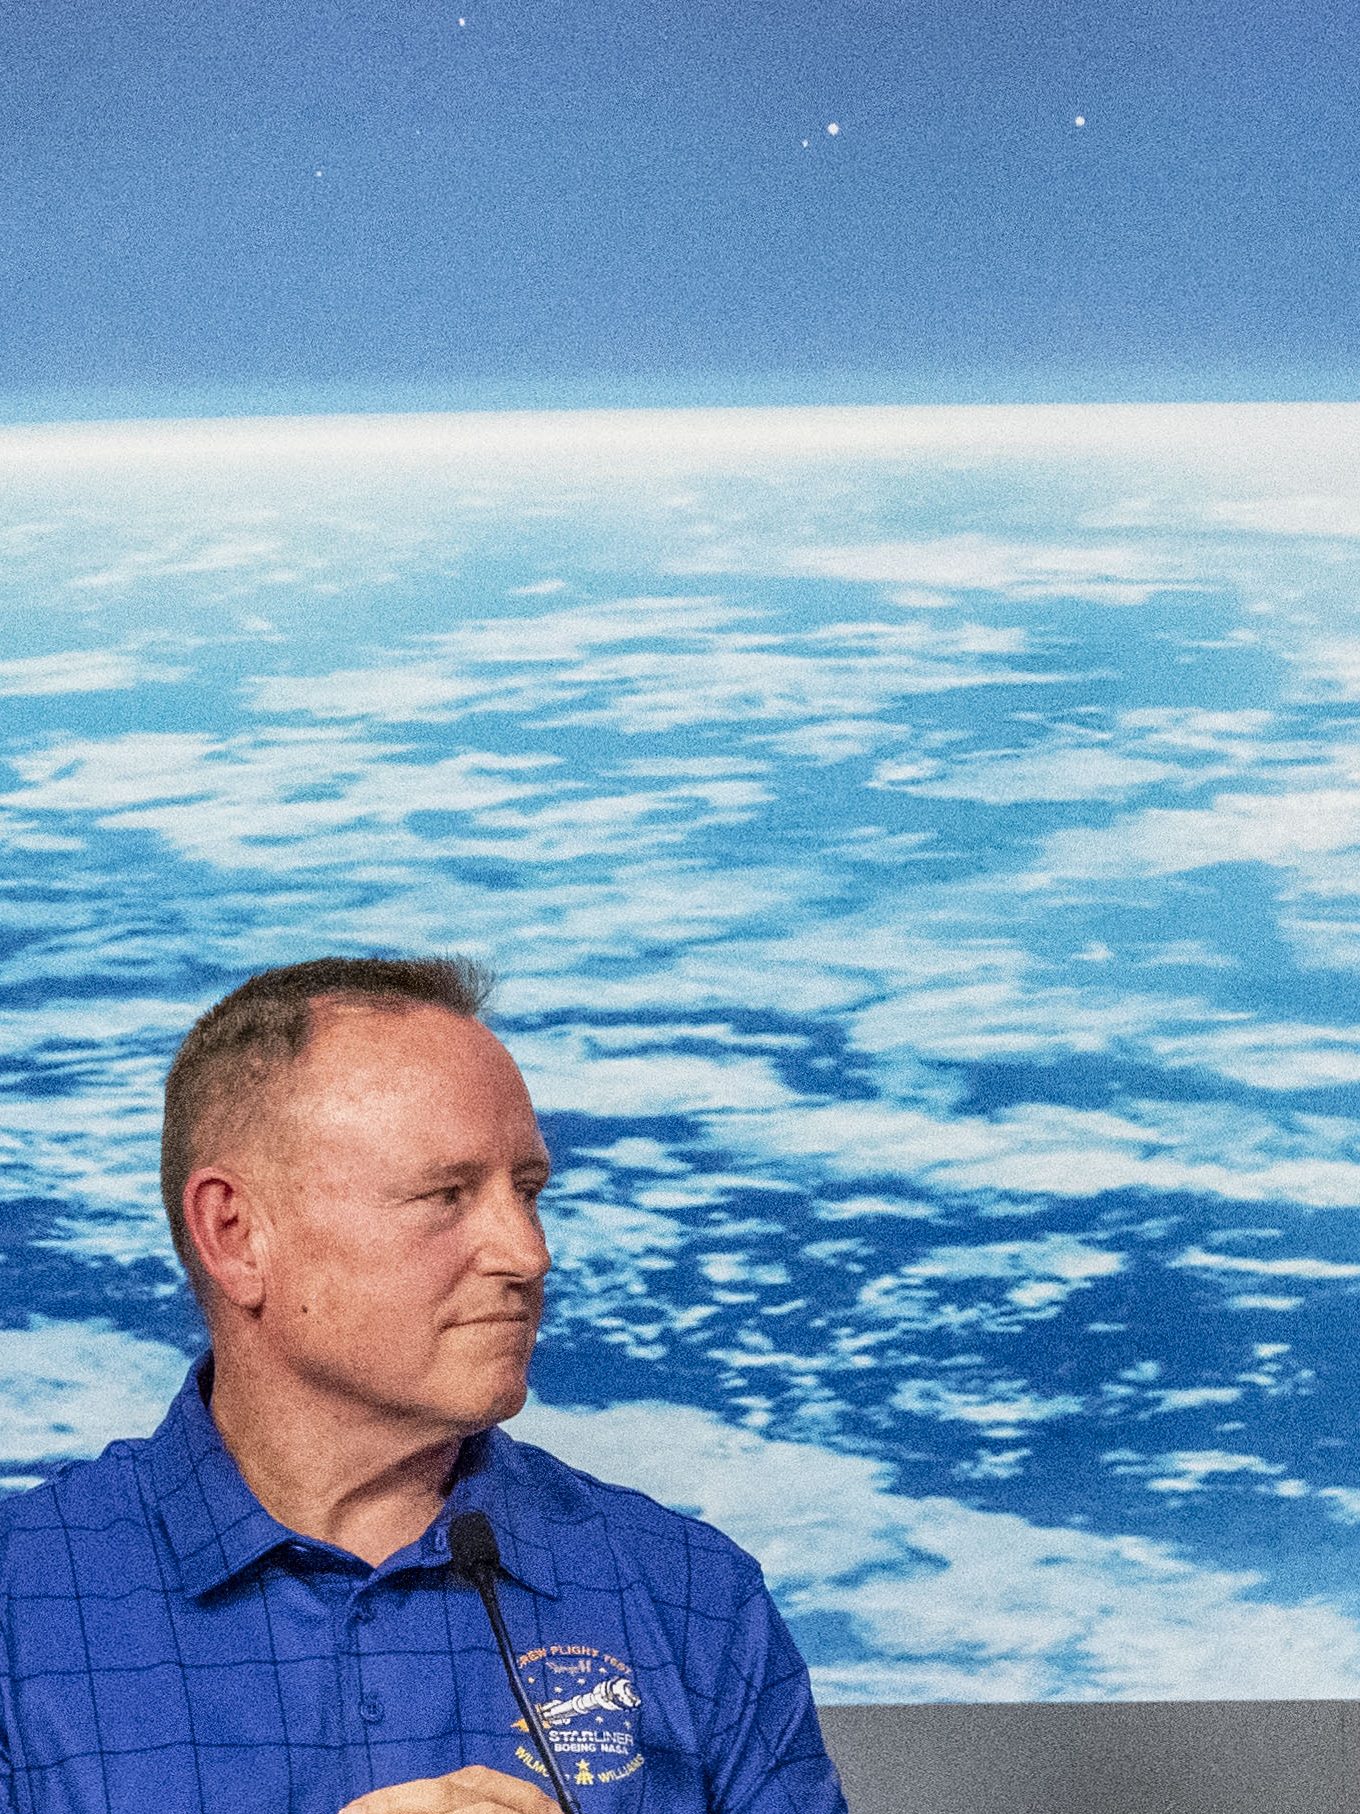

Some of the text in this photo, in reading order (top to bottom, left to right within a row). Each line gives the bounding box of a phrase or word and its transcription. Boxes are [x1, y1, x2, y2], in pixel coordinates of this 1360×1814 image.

[518, 1648, 547, 1669] REW
[548, 1730, 634, 1746] STARLINER
[554, 1743, 629, 1755] BOEING NASA
[597, 1753, 645, 1783] WILLIAMS
